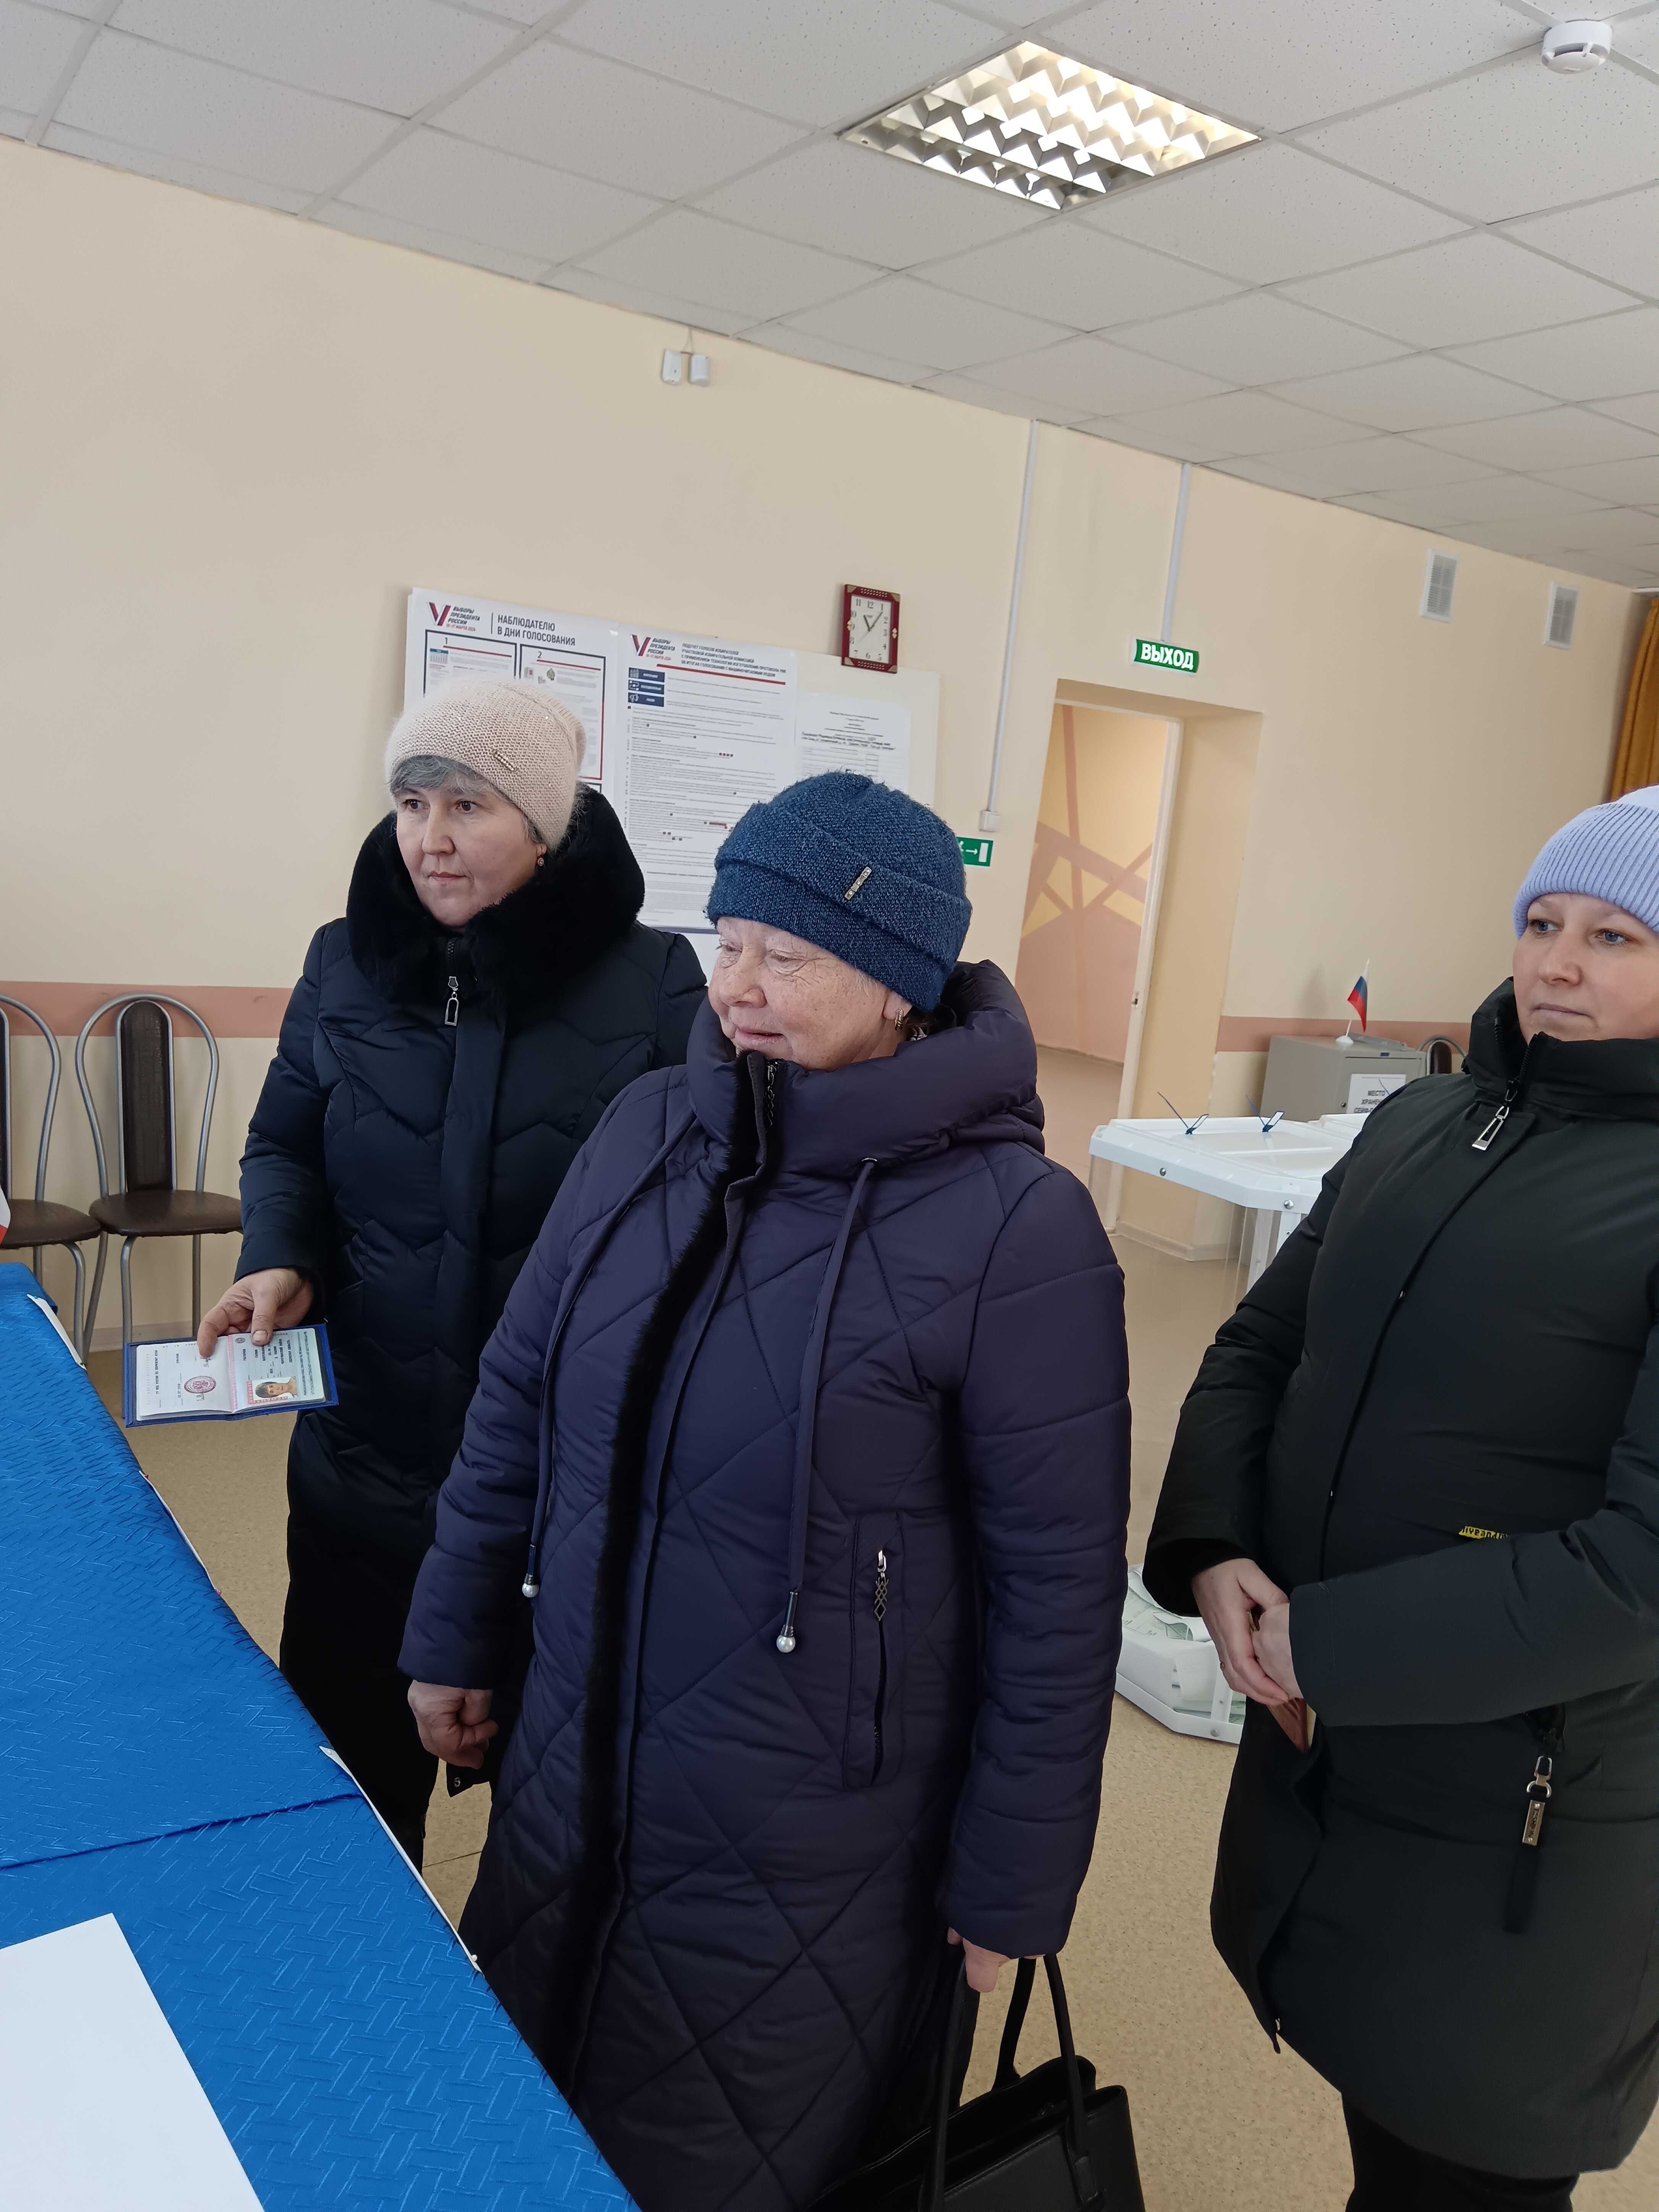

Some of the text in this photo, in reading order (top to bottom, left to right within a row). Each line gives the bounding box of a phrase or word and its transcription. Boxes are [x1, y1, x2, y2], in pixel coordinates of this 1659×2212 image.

[856, 598, 861, 606] 11
[867, 601, 874, 609] 12
[450, 612, 480, 621] ПРЕЗИДЕНТА
[498, 614, 555, 631] НАБЛЮДАТЕЛЮ
[498, 626, 575, 646] В ДНИ ГОЛОСОВАНИЯ
[854, 650, 858, 658] 7
[1141, 643, 1194, 670] ВЫХОД
